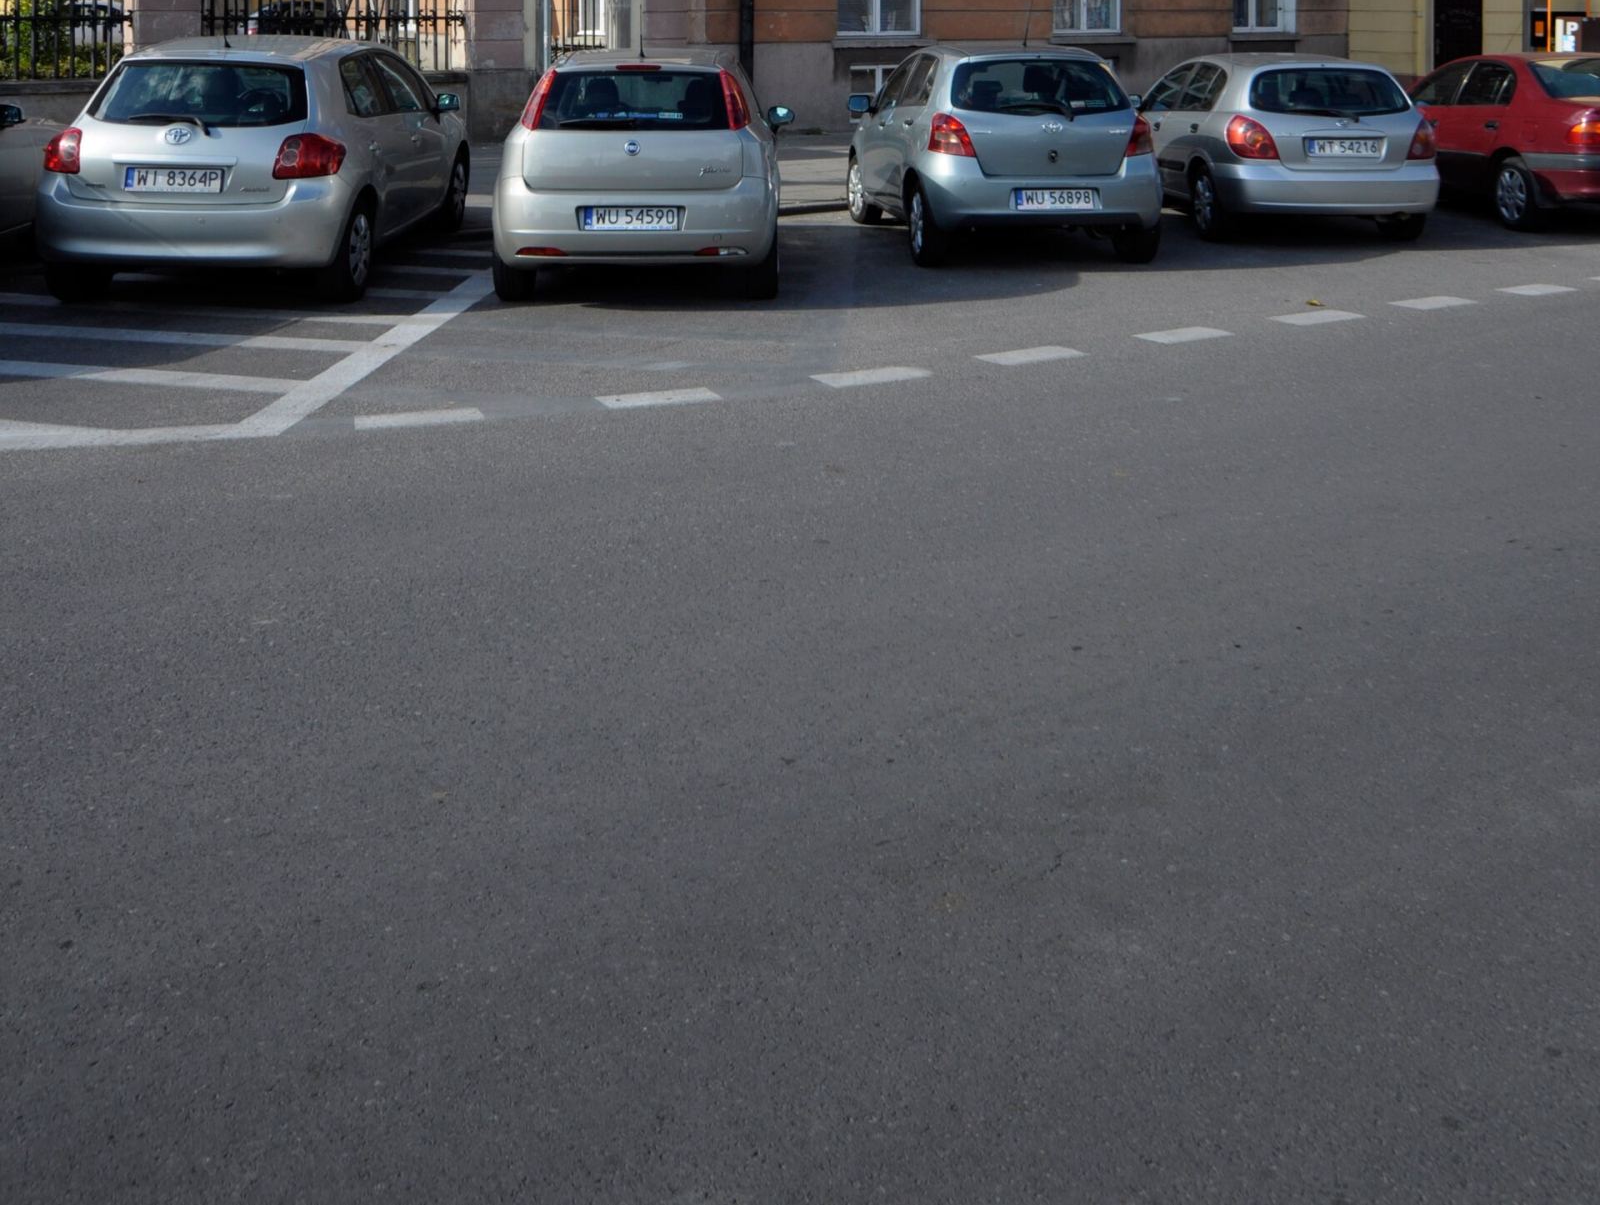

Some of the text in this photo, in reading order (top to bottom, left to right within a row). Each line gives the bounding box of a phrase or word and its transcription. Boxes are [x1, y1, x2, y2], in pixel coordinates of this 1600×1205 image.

[1318, 141, 1378, 153] WT 54216
[137, 170, 219, 188] WI 8364P
[1024, 190, 1091, 205] WU 56898
[596, 209, 675, 225] WU 54590
